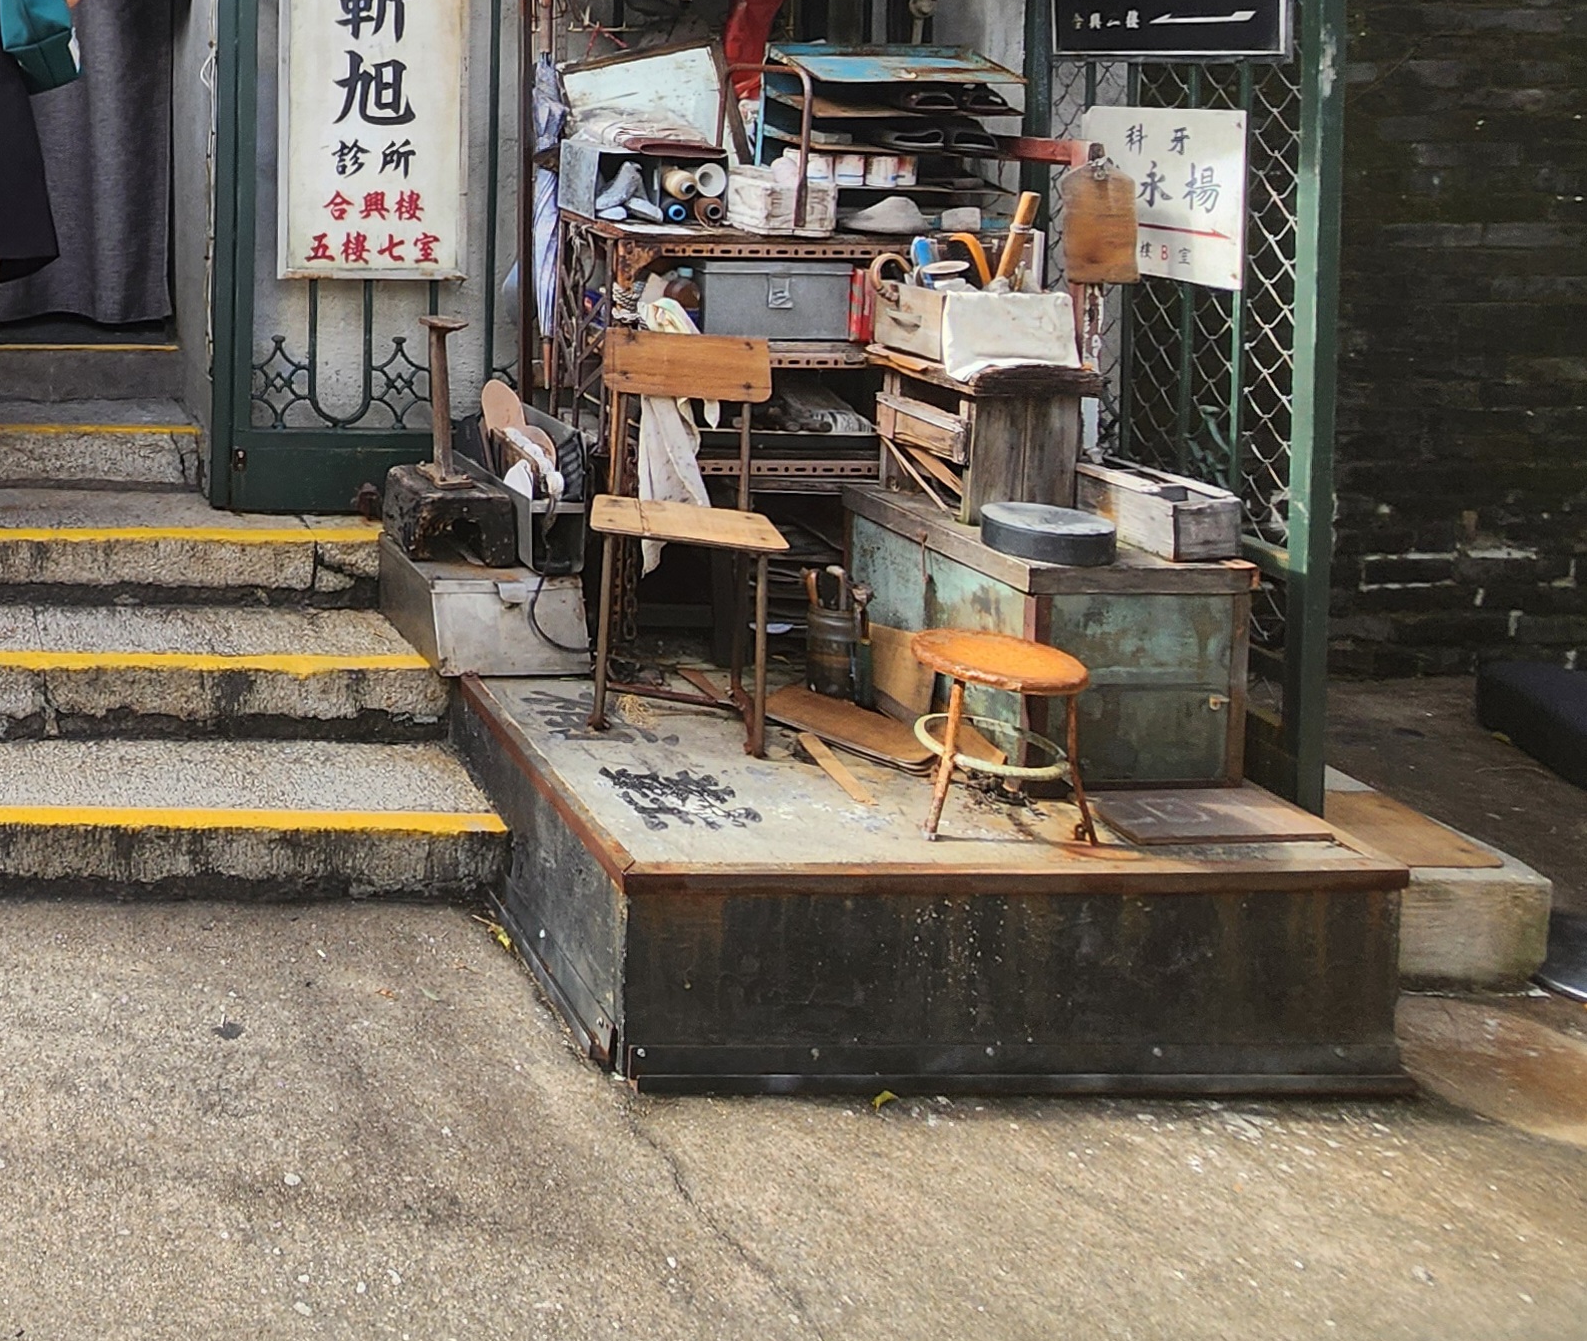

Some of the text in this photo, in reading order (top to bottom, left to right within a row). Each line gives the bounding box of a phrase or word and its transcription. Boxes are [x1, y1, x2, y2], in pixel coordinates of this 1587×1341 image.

[1124, 123, 1191, 156] 牙科
[331, 139, 417, 181] 診所
[322, 189, 425, 222] 合興樓
[304, 231, 441, 266] 五樓七室
